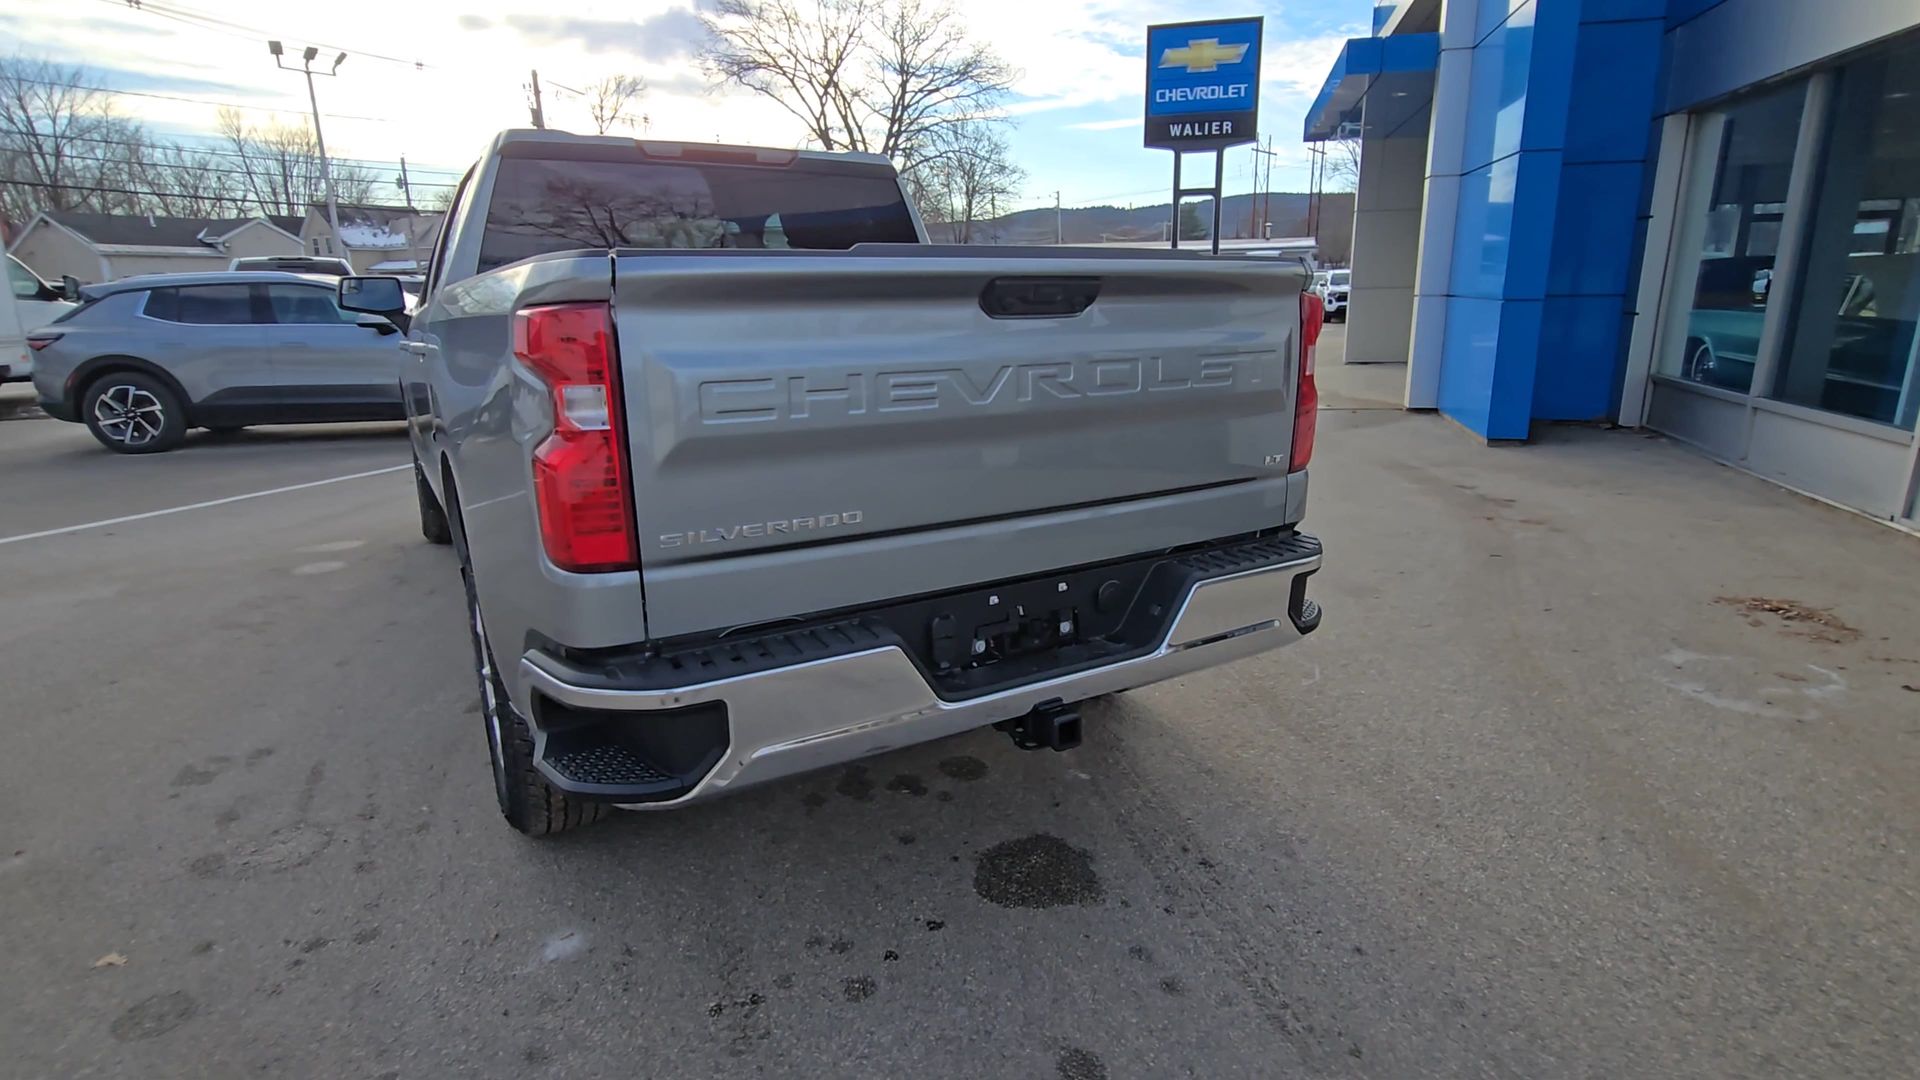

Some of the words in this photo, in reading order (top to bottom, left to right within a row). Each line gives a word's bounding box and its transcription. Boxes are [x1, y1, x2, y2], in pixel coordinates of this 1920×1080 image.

[1155, 83, 1248, 103] CHEVROLET
[1169, 121, 1233, 137] WALIER
[698, 350, 1277, 426] CHEVROLET
[1263, 454, 1284, 466] LT
[659, 510, 864, 549] SILVERADO
